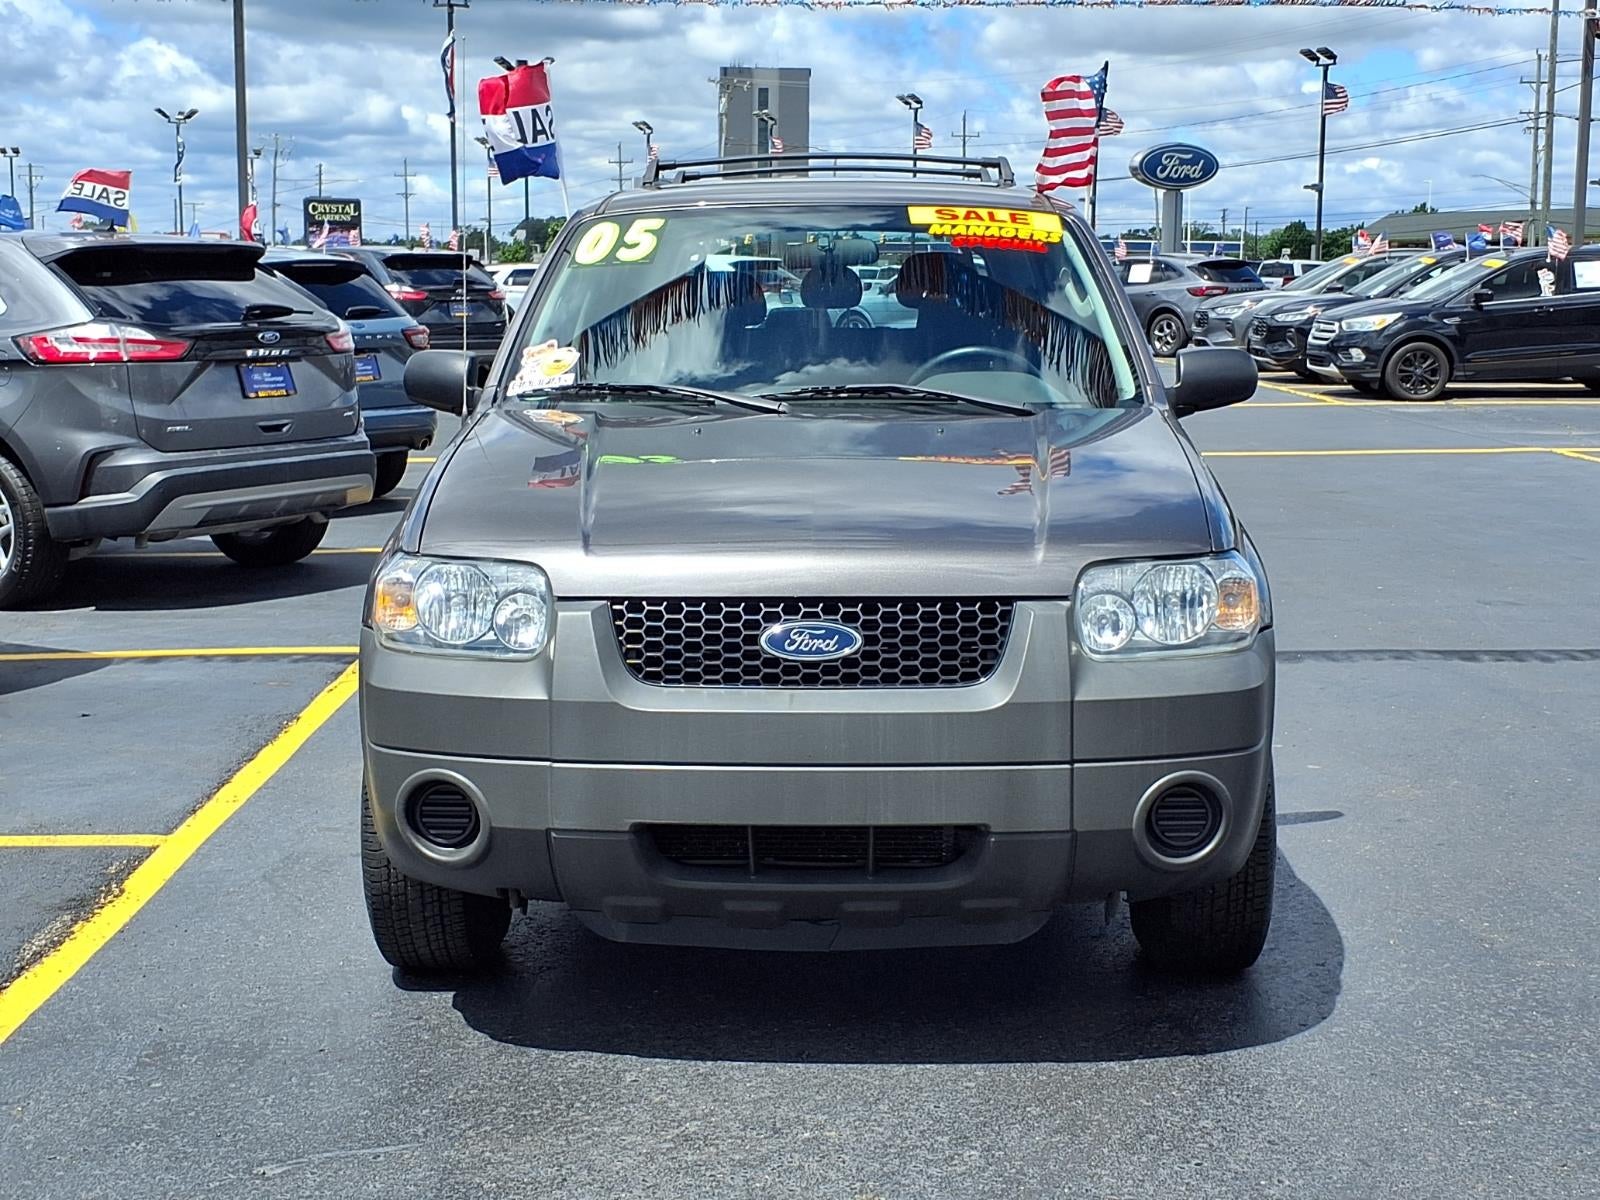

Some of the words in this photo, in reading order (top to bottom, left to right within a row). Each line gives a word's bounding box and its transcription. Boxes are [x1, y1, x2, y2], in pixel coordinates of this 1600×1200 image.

[1156, 152, 1204, 179] Ford
[308, 202, 359, 216] CRYSTAL
[934, 208, 1031, 226] SALE
[575, 218, 666, 265] 05
[928, 223, 1064, 243] MANAGERS
[951, 235, 1049, 253] SPECIAL
[784, 627, 839, 652] Ford
